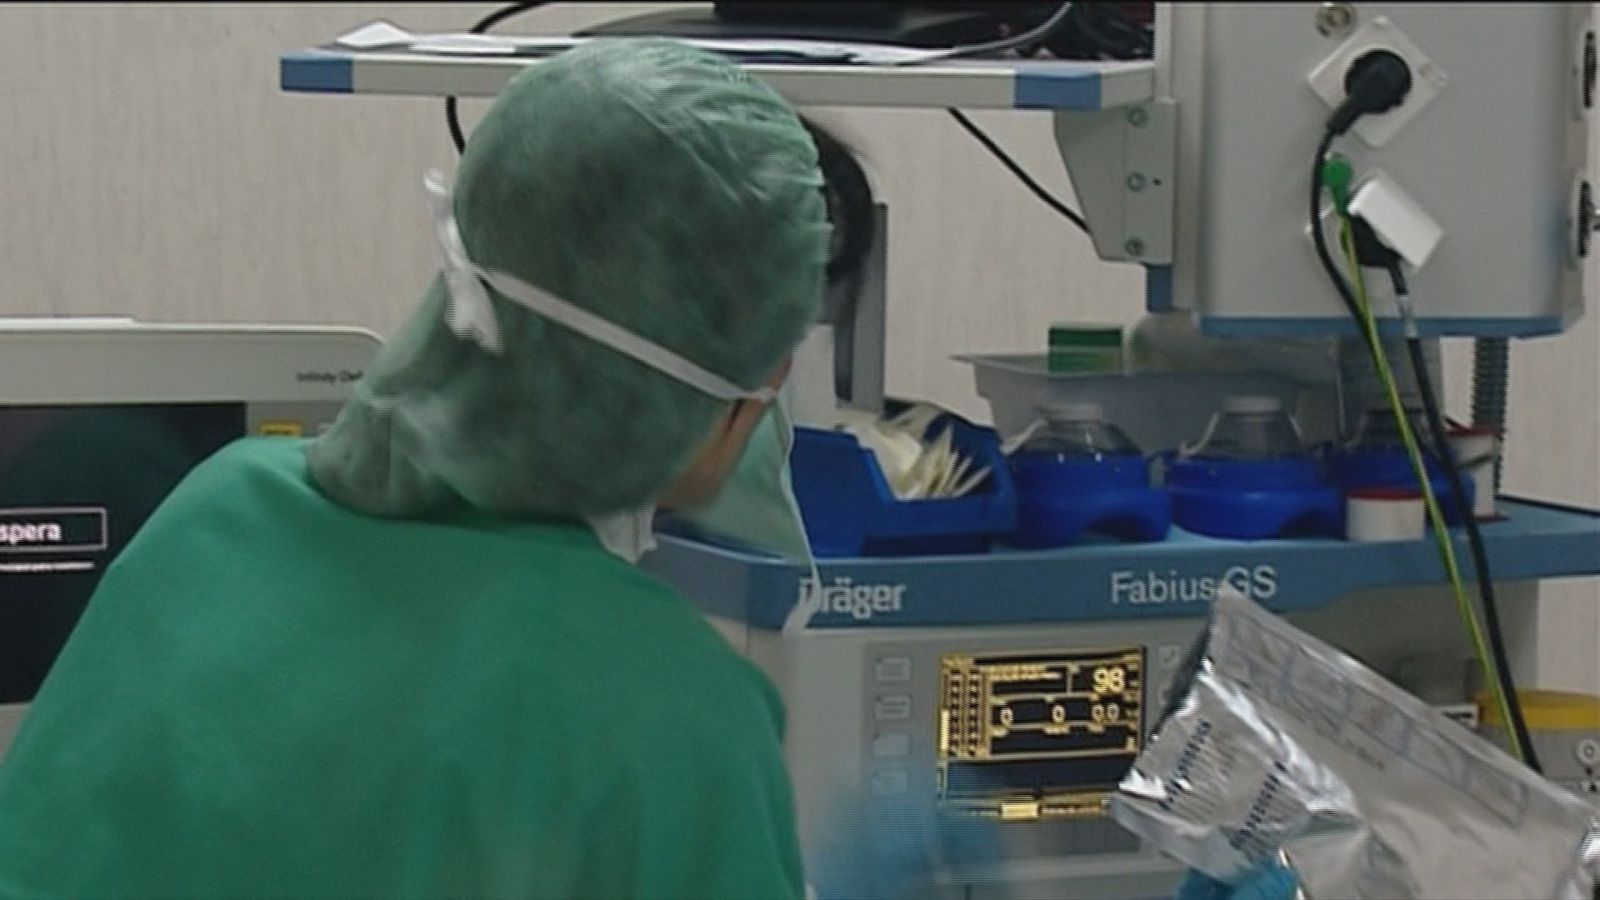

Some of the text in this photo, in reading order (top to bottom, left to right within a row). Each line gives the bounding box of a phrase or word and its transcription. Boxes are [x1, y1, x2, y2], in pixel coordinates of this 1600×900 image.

[1111, 565, 1277, 602] Fabius GS
[1093, 667, 1125, 693] 98
